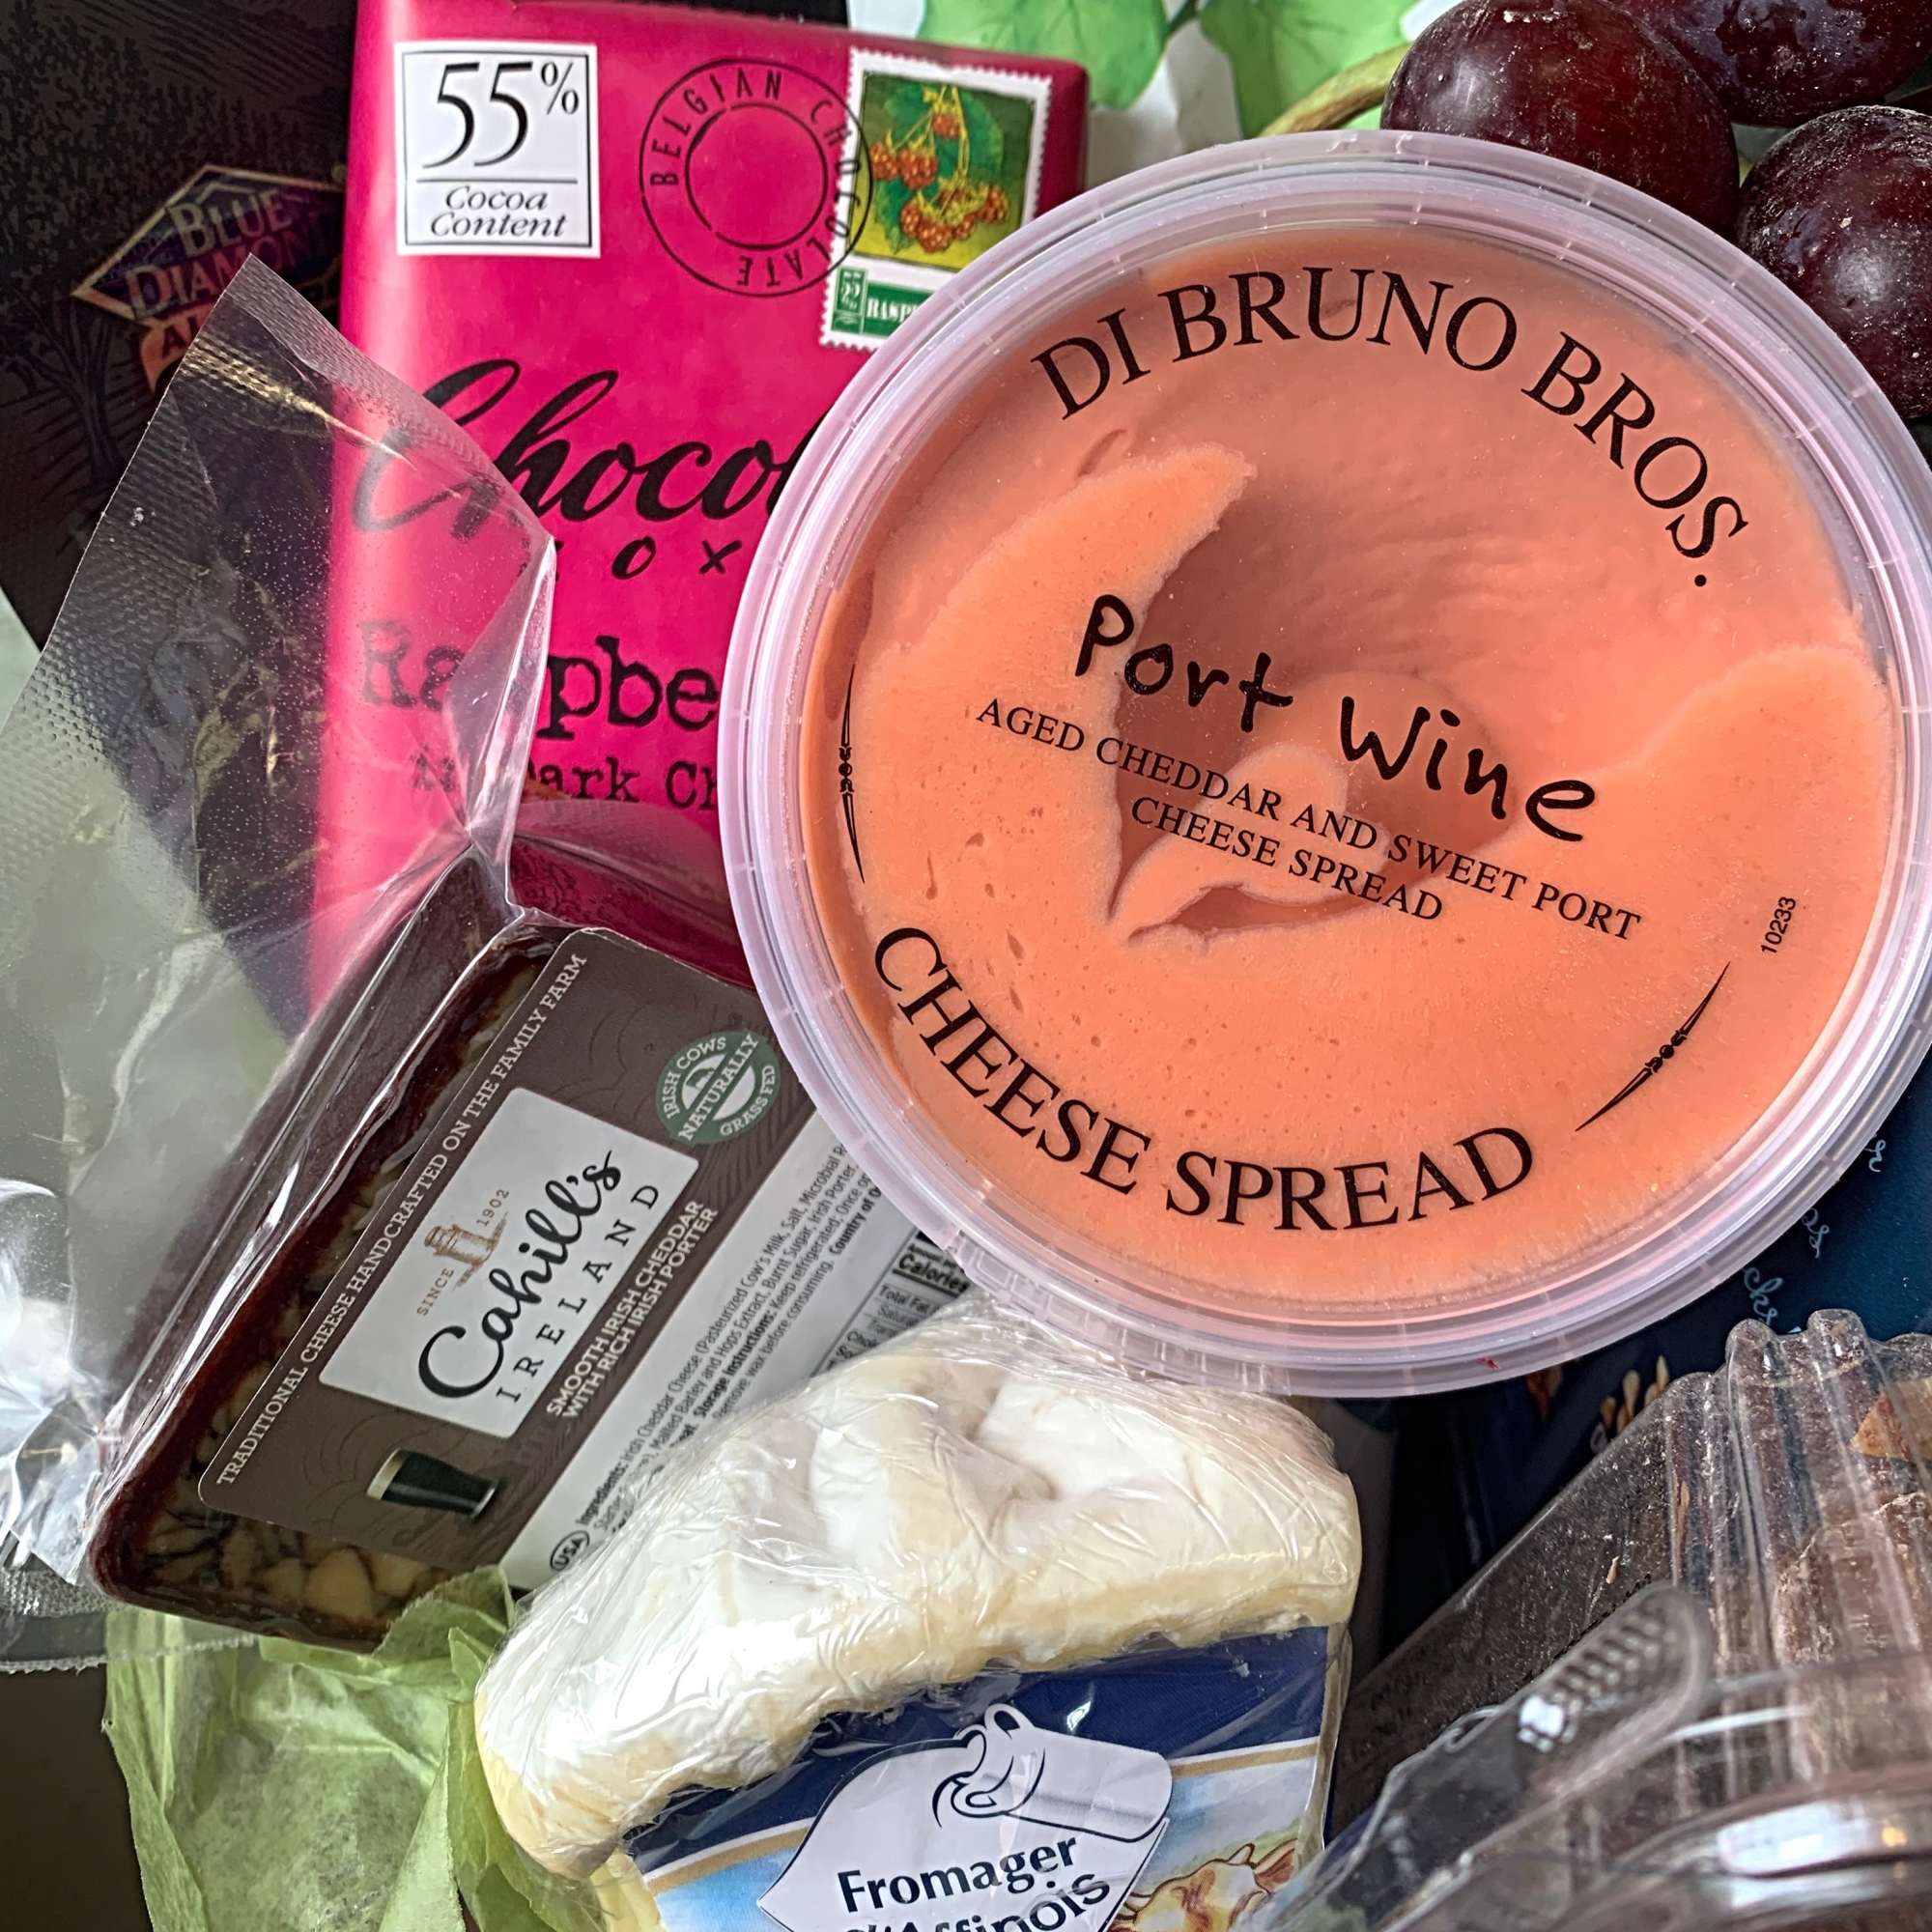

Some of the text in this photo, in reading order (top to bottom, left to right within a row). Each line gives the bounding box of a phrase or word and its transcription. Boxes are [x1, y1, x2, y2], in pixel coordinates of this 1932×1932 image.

[422, 61, 580, 169] 55%
[168, 190, 293, 259] BLUE
[431, 212, 568, 238] Content
[445, 185, 549, 212] Cocoa
[650, 67, 861, 288] BELGIAN CHOCOLATE
[125, 218, 330, 318] DIAMON
[867, 298, 921, 325] RASP
[1031, 267, 1749, 588] DI BRUNO BROS.
[359, 620, 720, 740] Rapbe
[527, 756, 639, 803] ark
[977, 697, 1642, 942] AGED CHEDDAR AND SWEET PORT
[1340, 696, 1596, 842] Wine
[1131, 796, 1444, 923] CHEESE SPREAD
[1761, 896, 1796, 953] 10233
[663, 1037, 726, 1119] IRISH COWS
[678, 1034, 758, 1141] NATURALLY
[720, 1065, 775, 1135] GRASS FED
[874, 926, 1535, 1232] CHEESE SPREAD
[215, 953, 587, 1484] TRADITIONAL CHEESE HANDCRAFTED ON THE FAMILY FARM
[476, 1189, 510, 1228] 1902
[416, 1267, 455, 1317] SINCE
[418, 1150, 621, 1398] Cahill's
[497, 1184, 659, 1403] IRELAND
[546, 1201, 705, 1416] SMOOTH IRISH CHEDDAR
[562, 1208, 718, 1417] WITH RICH IRISH PORTER
[649, 1413, 684, 1449] Malted
[674, 1379, 707, 1414] Barley
[701, 1356, 723, 1379] and
[714, 1330, 743, 1357] Hops
[761, 1258, 791, 1290] Burnt
[808, 1199, 833, 1224] Irish
[693, 1378, 727, 1417] Storage
[723, 1310, 777, 1377] Instructions:
[769, 1282, 797, 1309] Keep
[835, 1188, 860, 1214] Once
[747, 1354, 766, 1377] wax
[759, 1320, 788, 1354] before
[786, 1261, 834, 1319] consuming.
[829, 1211, 867, 1254] Country
[861, 1197, 874, 1211] of
[898, 1253, 971, 1293] Calories
[576, 1463, 628, 1525] Ingredients:
[620, 1438, 644, 1462] Irish
[637, 1393, 674, 1435] Cheddar
[668, 1355, 702, 1392] Cheese
[695, 1287, 749, 1354] (Pasteurized
[740, 1257, 771, 1288] Cow's
[799, 1155, 840, 1205] Microbial
[553, 1531, 584, 1570] USA
[837, 1836, 1078, 1914] Fromager
